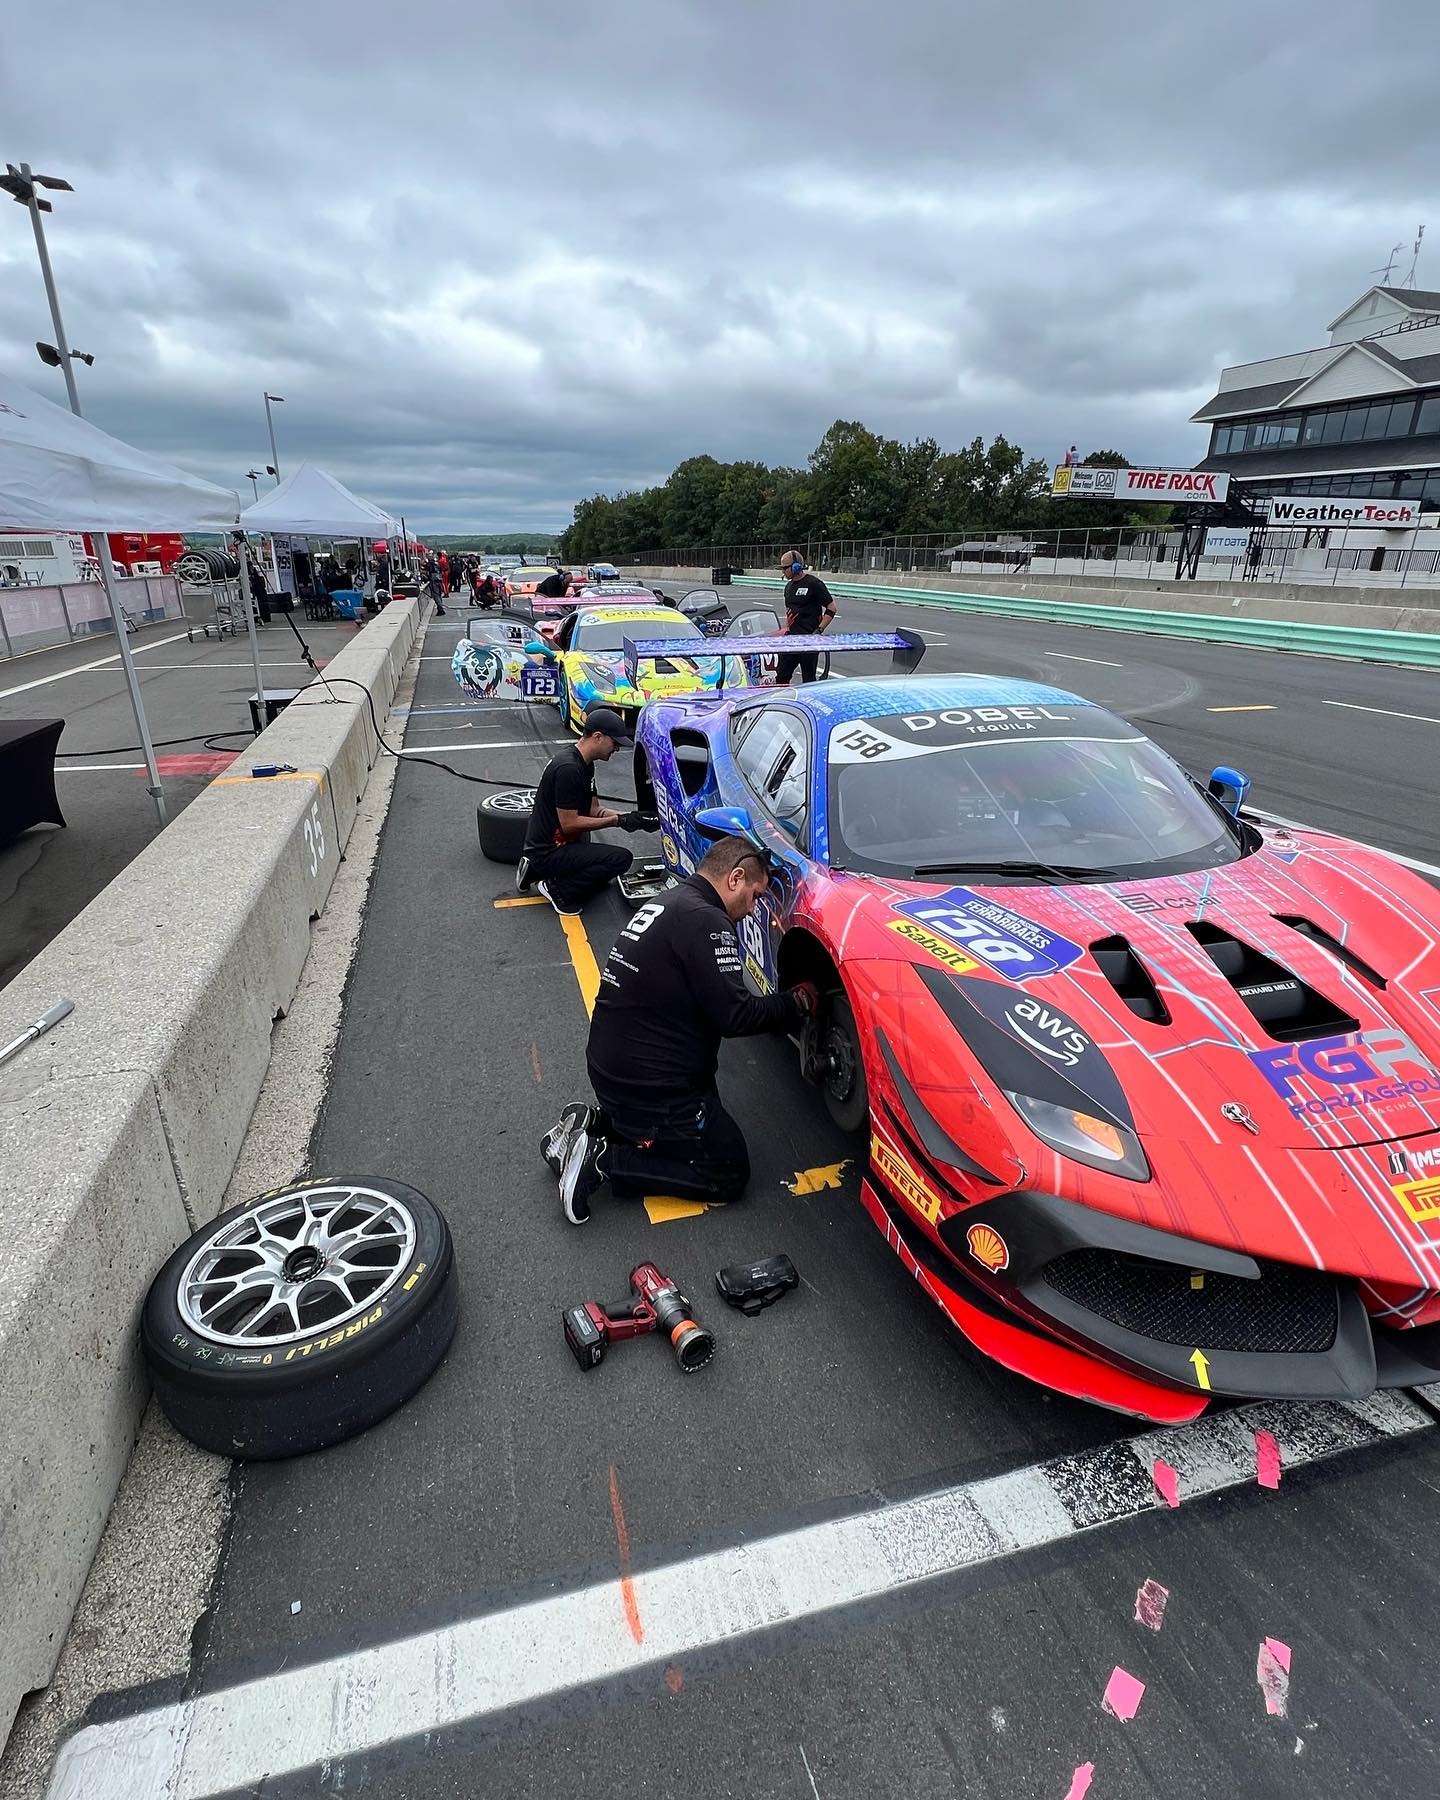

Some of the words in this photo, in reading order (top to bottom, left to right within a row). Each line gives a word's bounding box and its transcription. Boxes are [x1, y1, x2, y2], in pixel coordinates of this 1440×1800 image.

[1127, 472, 1168, 489] TIRE
[1168, 473, 1217, 500] RACK
[1184, 491, 1208, 500] .com
[1274, 503, 1412, 522] WeatherTech
[1207, 537, 1224, 547] NTT
[605, 610, 661, 618] DOBEL
[526, 678, 556, 695] 123
[901, 706, 1071, 733] DOBEL
[966, 721, 1036, 735] TEQUILA
[836, 729, 892, 759] 158
[914, 909, 1035, 962] 158
[962, 900, 1051, 949] FERRARIRACES
[896, 923, 969, 967] Sabelt
[1239, 986, 1274, 997] RICHARD
[1272, 982, 1297, 991] MILLE
[1014, 998, 1089, 1054] aws
[1289, 1075, 1440, 1121] FORZAGROU
[1410, 1148, 1440, 1169] IMS
[877, 1144, 933, 1214] PIRELLI
[285, 1306, 383, 1361] PIRELLI
